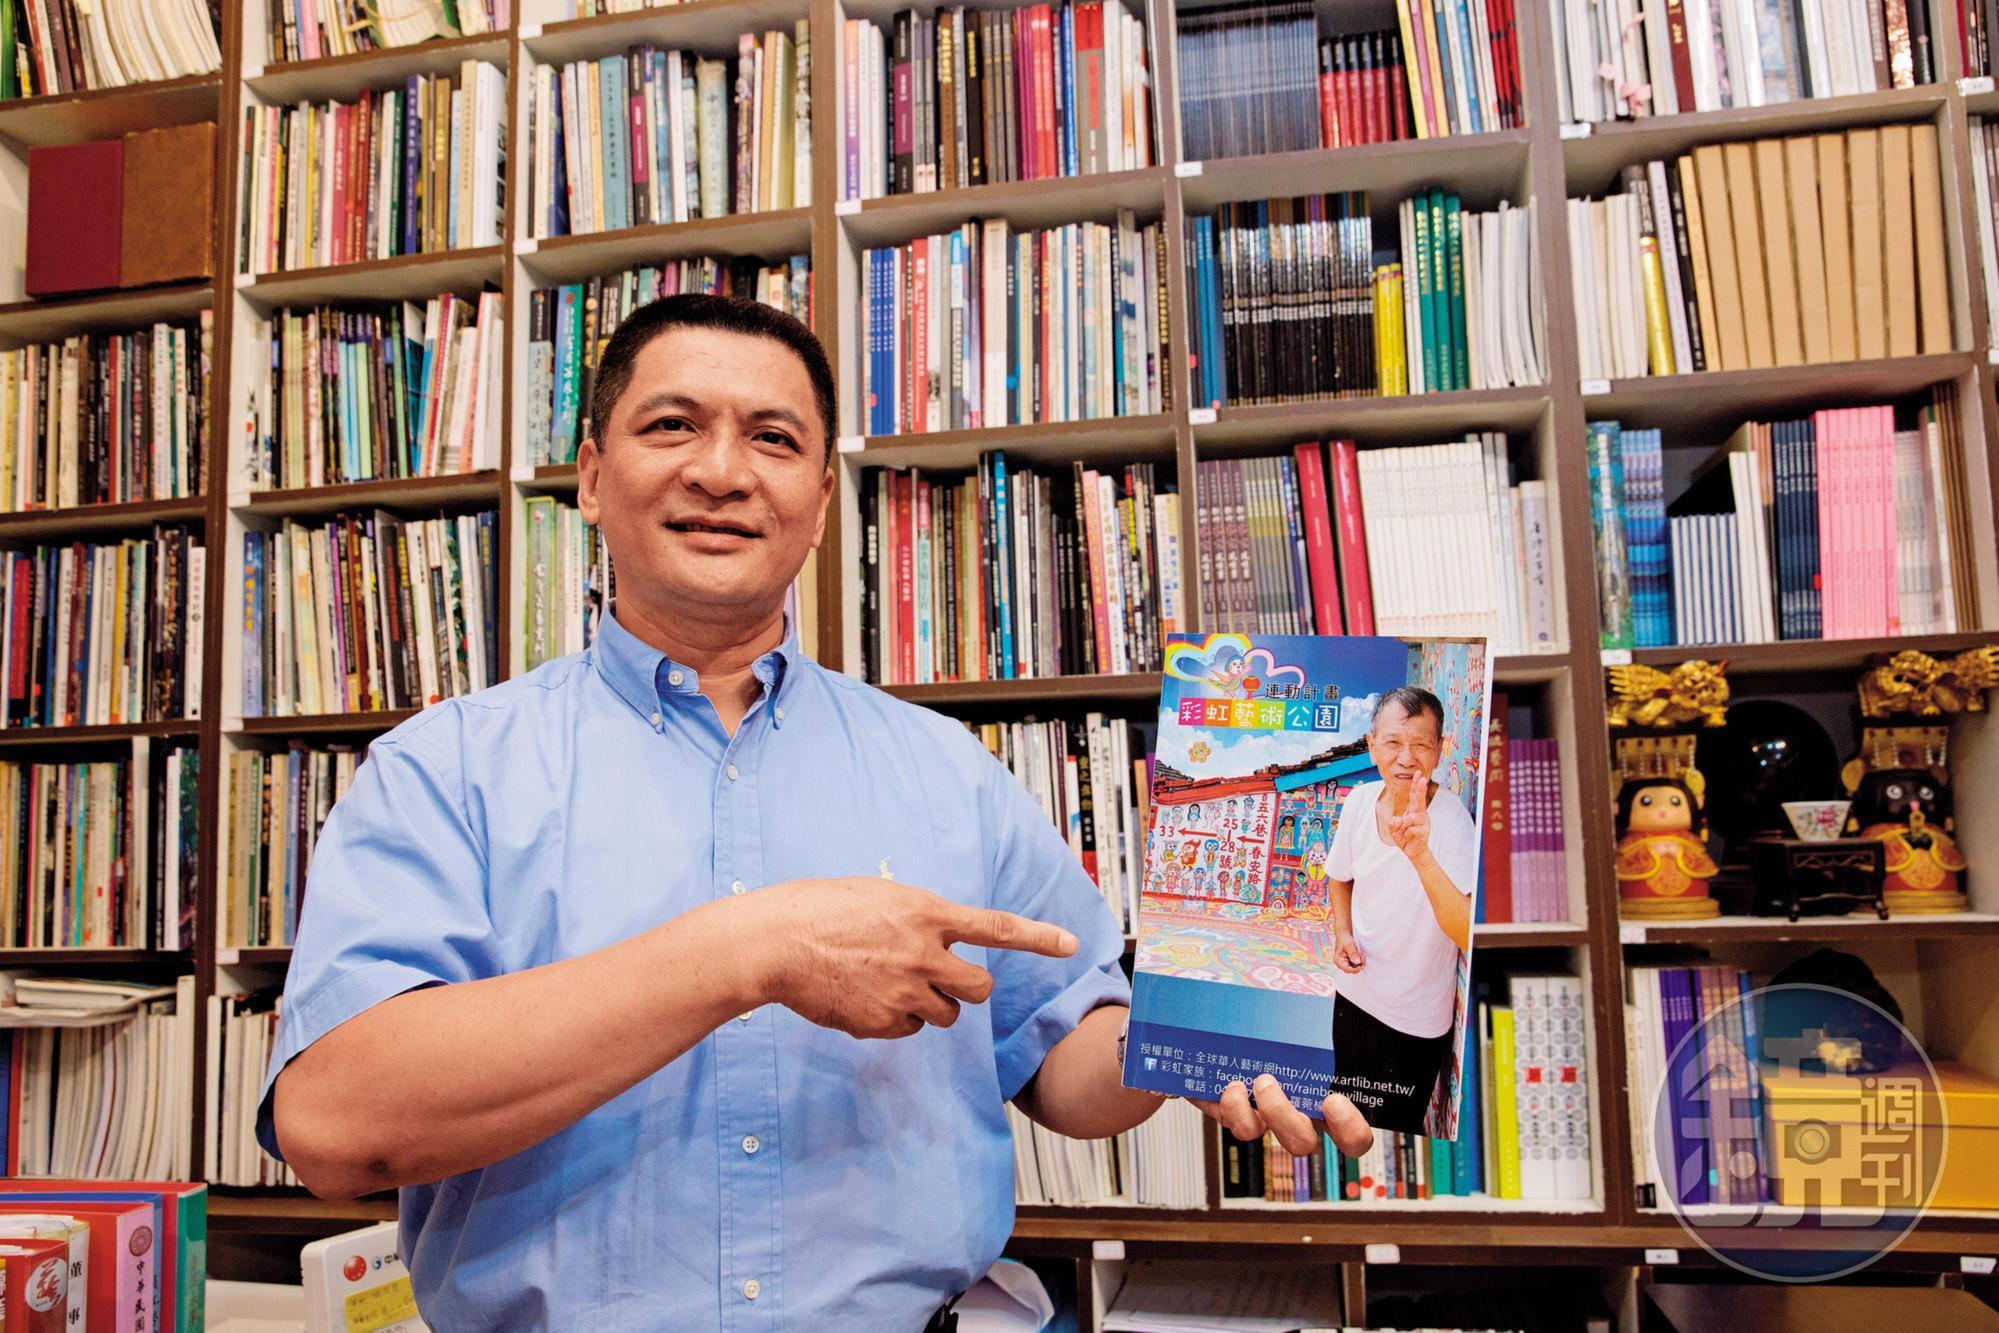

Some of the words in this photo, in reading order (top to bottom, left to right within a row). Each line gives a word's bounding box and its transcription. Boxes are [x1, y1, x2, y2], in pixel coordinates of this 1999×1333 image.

[1181, 700, 1339, 730] 彩虹藝術公園
[1223, 818, 1239, 830] 25
[1159, 825, 1175, 838] 33
